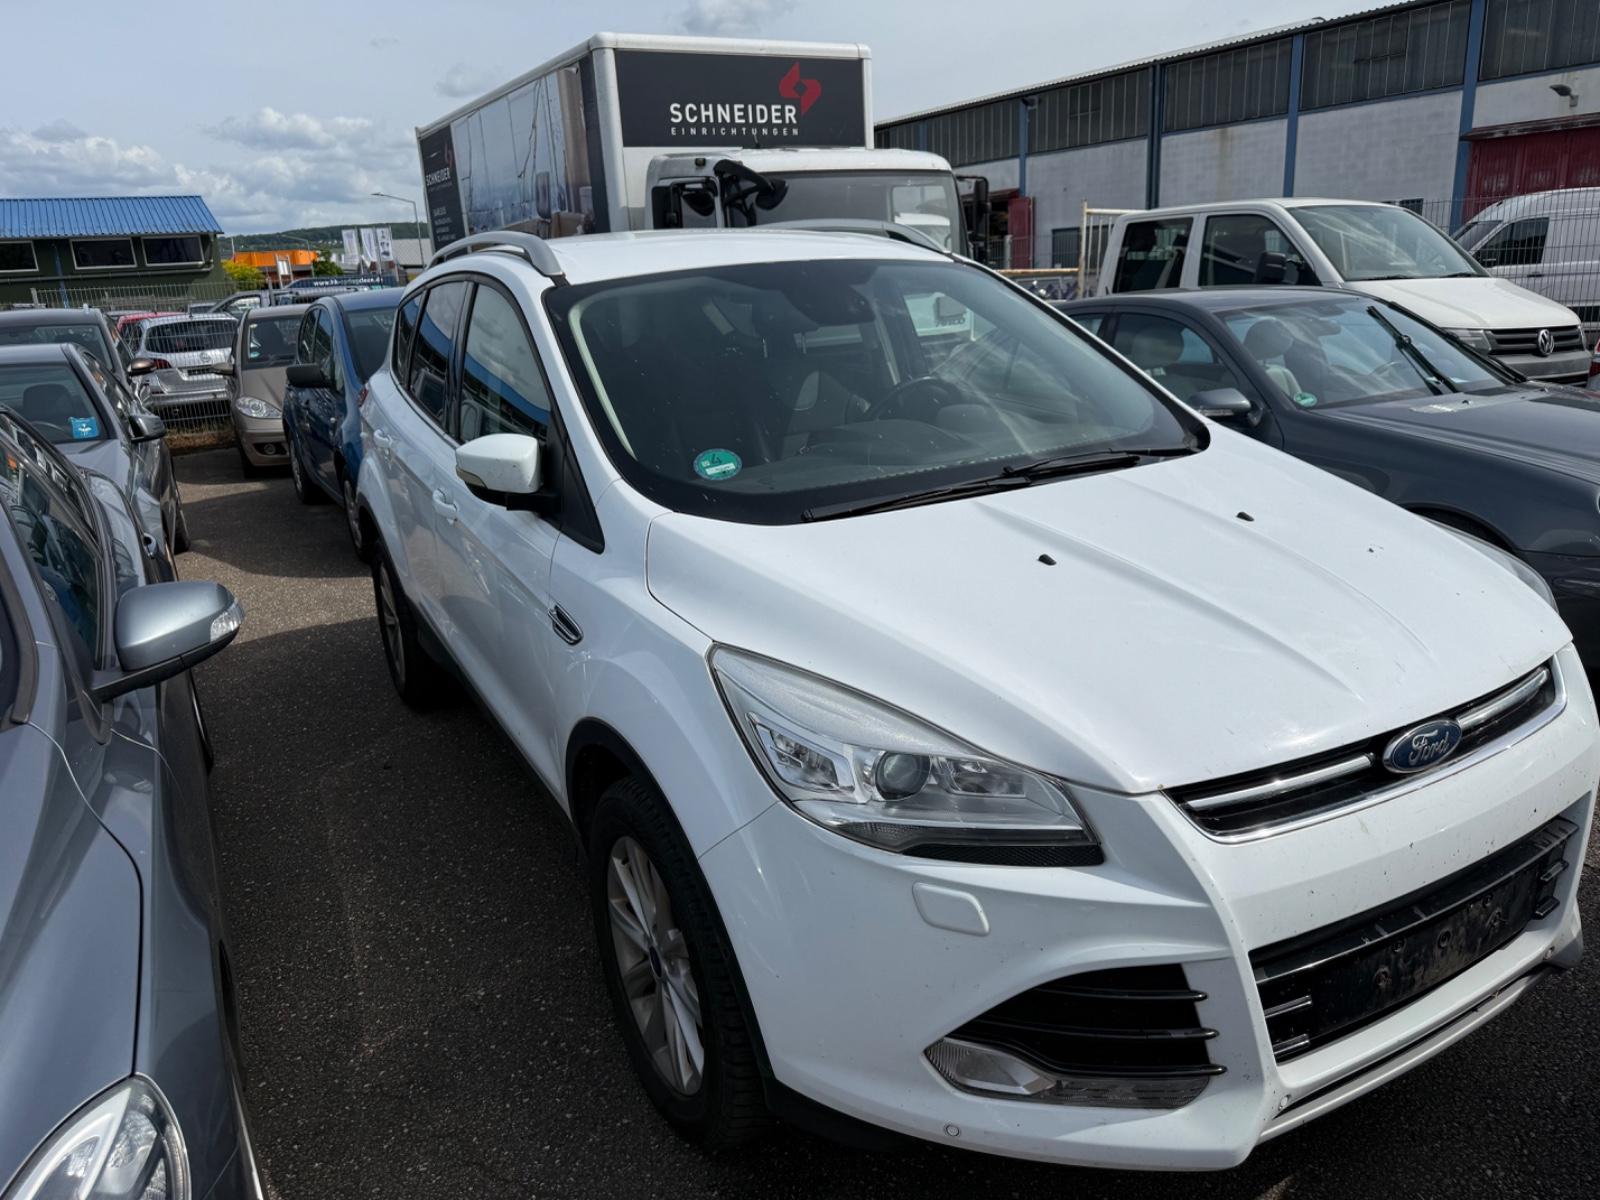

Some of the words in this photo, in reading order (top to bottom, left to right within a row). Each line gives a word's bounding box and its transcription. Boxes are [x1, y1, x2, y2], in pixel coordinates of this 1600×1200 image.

[670, 103, 797, 124] SCHNEIDER
[671, 127, 799, 136] EINRICHTUNGEN
[1408, 729, 1449, 766] Ford
